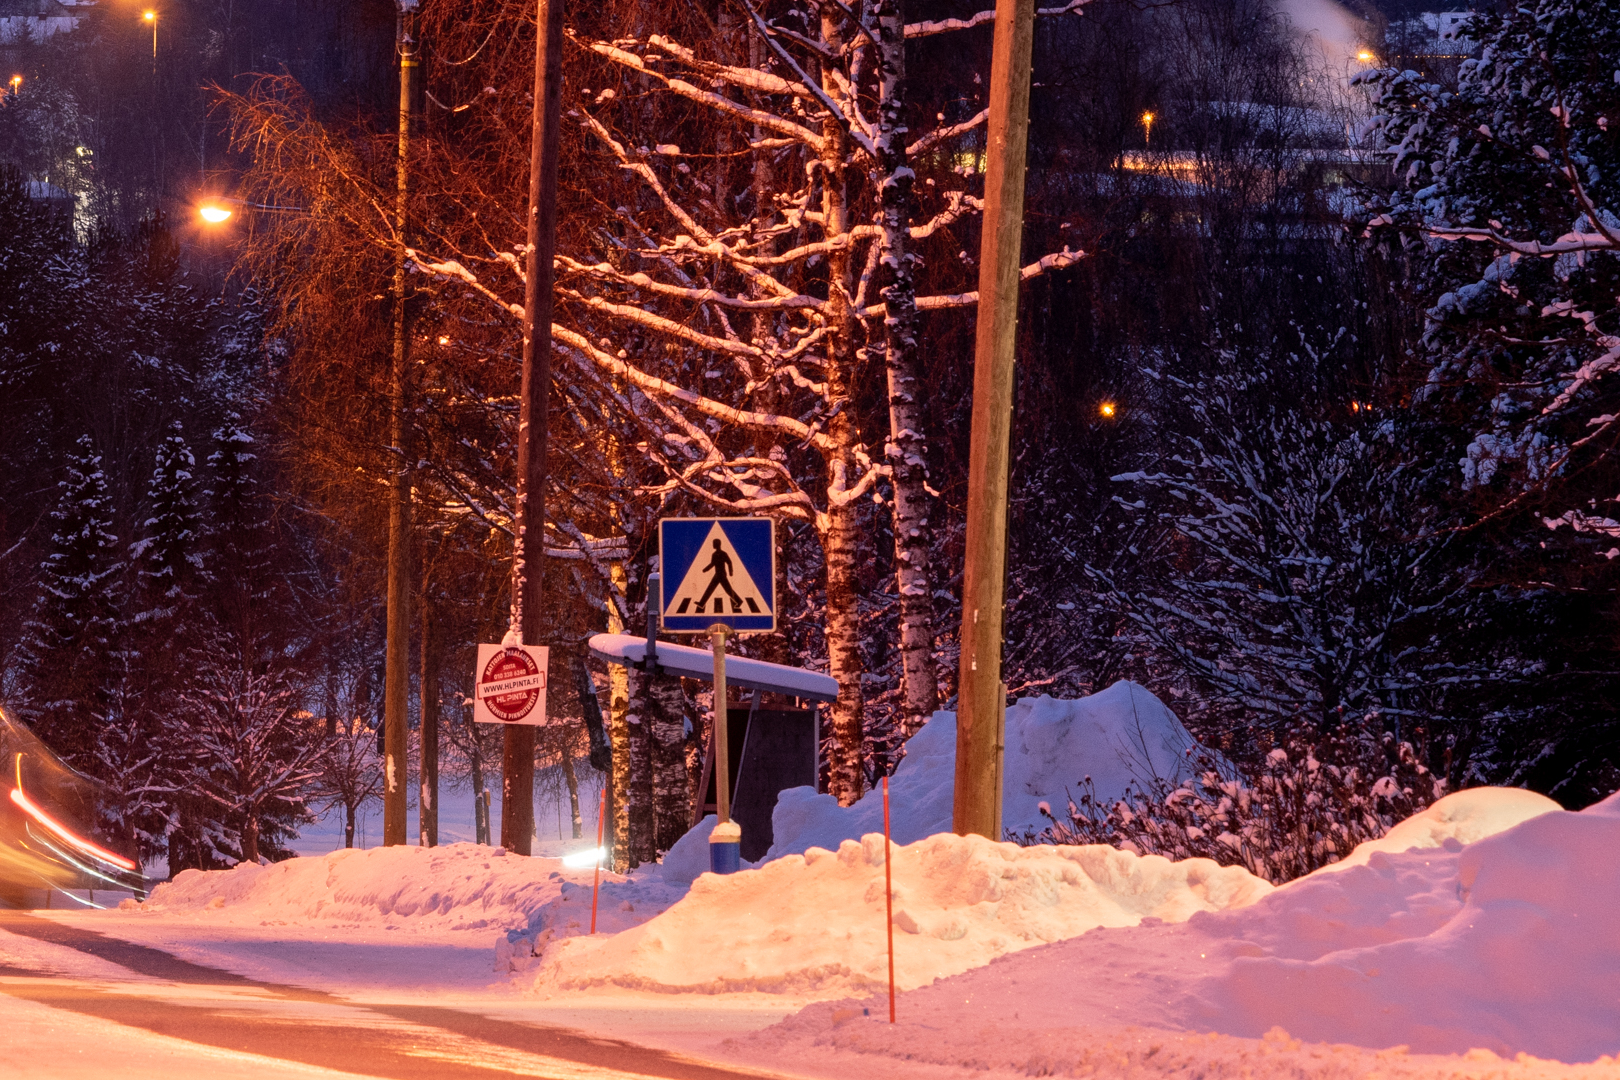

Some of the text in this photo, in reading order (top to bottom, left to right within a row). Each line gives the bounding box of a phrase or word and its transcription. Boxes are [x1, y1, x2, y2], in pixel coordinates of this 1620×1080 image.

[502, 663, 516, 671] SOITA
[483, 677, 539, 694] WWW.HLPINTA.FI
[496, 696, 506, 704] HL
[507, 692, 528, 702] PINTA
